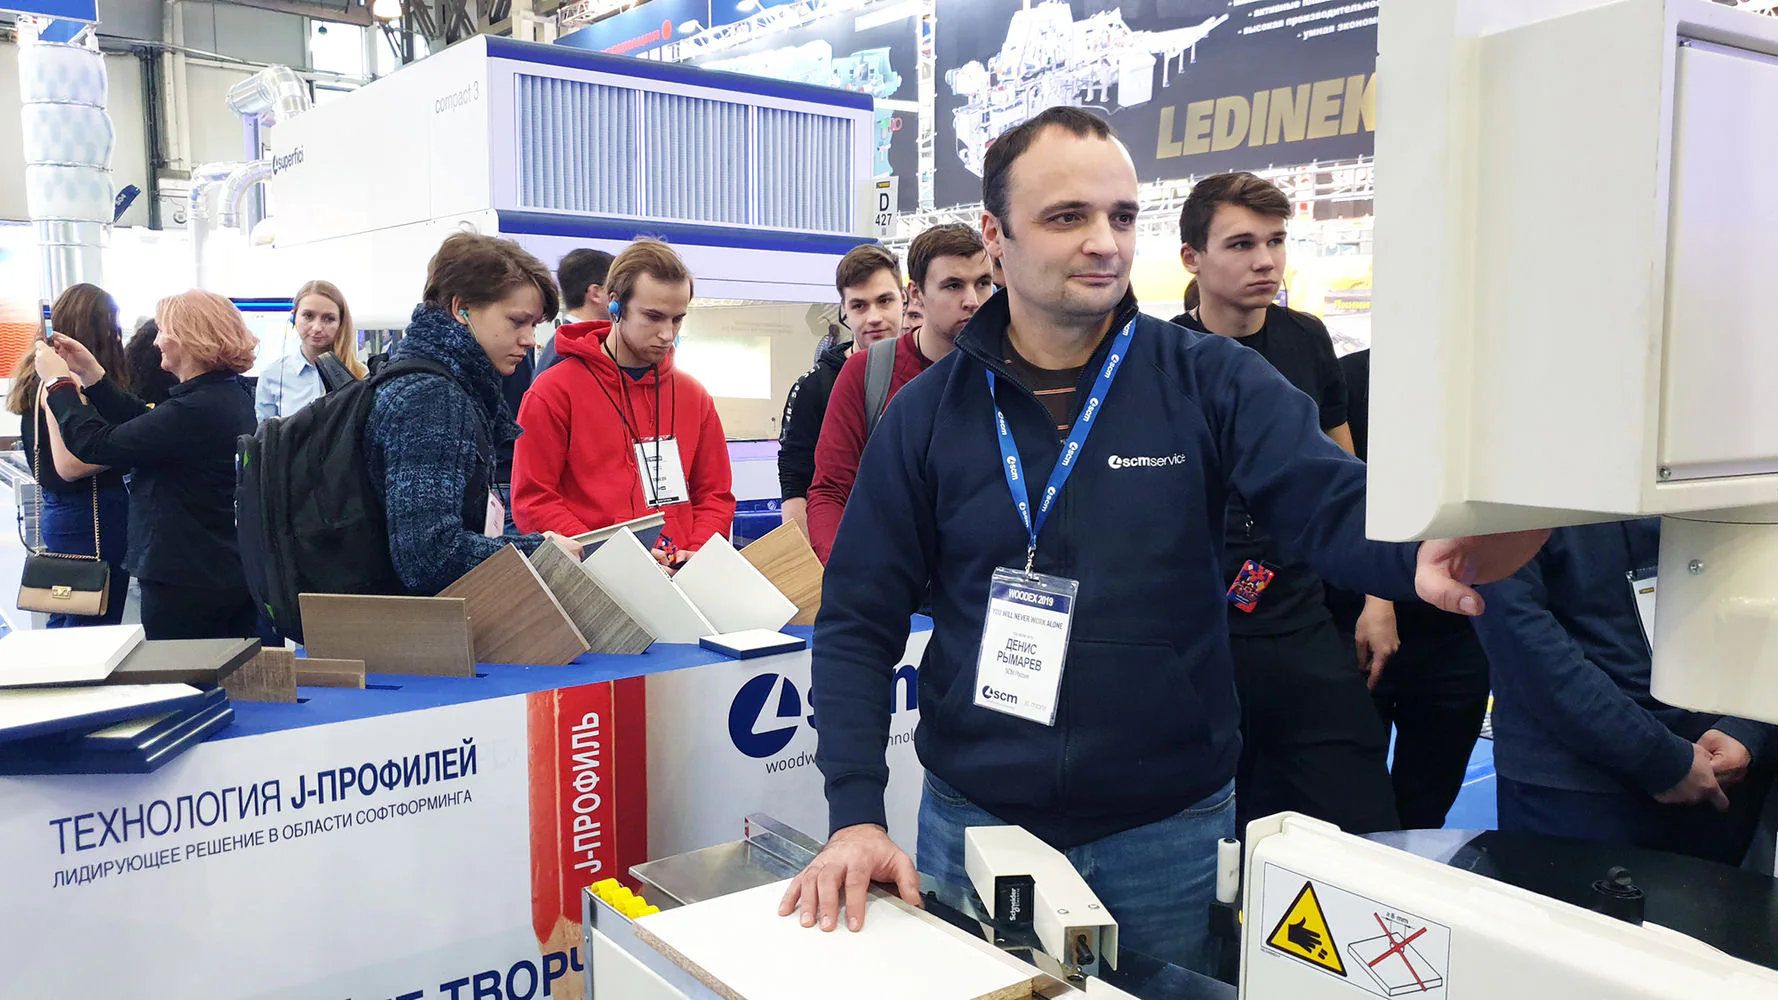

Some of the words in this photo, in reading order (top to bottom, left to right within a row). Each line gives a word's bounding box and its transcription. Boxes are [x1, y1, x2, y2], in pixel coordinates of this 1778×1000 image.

[434, 84, 472, 114] compact
[473, 81, 480, 101] 3
[1156, 72, 1376, 160] LEDINEK
[278, 145, 304, 171] superfici
[879, 192, 890, 212] D
[875, 213, 893, 226] 427
[1008, 588, 1038, 604] WOODEX
[1038, 595, 1054, 607] 2019
[1014, 613, 1030, 622] NEVER
[1046, 619, 1063, 630] ALONE
[1005, 638, 1037, 655] ДЕНИС
[996, 650, 1042, 671] РЫМАРЕВ
[993, 690, 1018, 704] scm
[49, 779, 281, 855] ТЕХНОЛОГИЯ
[291, 737, 477, 810] J-ПРОФИЛЕЙ
[572, 711, 602, 873] J-ПРОФИЛЬ
[53, 846, 181, 889] ЛИДИРУЮЩЕЕ
[185, 829, 265, 860] РЕШЕНИЕ
[268, 827, 279, 844] В
[282, 812, 353, 840] ОБЛАСТИ
[356, 789, 473, 825] СОФТФОРМИНГА
[1009, 887, 1017, 921] Schneider
